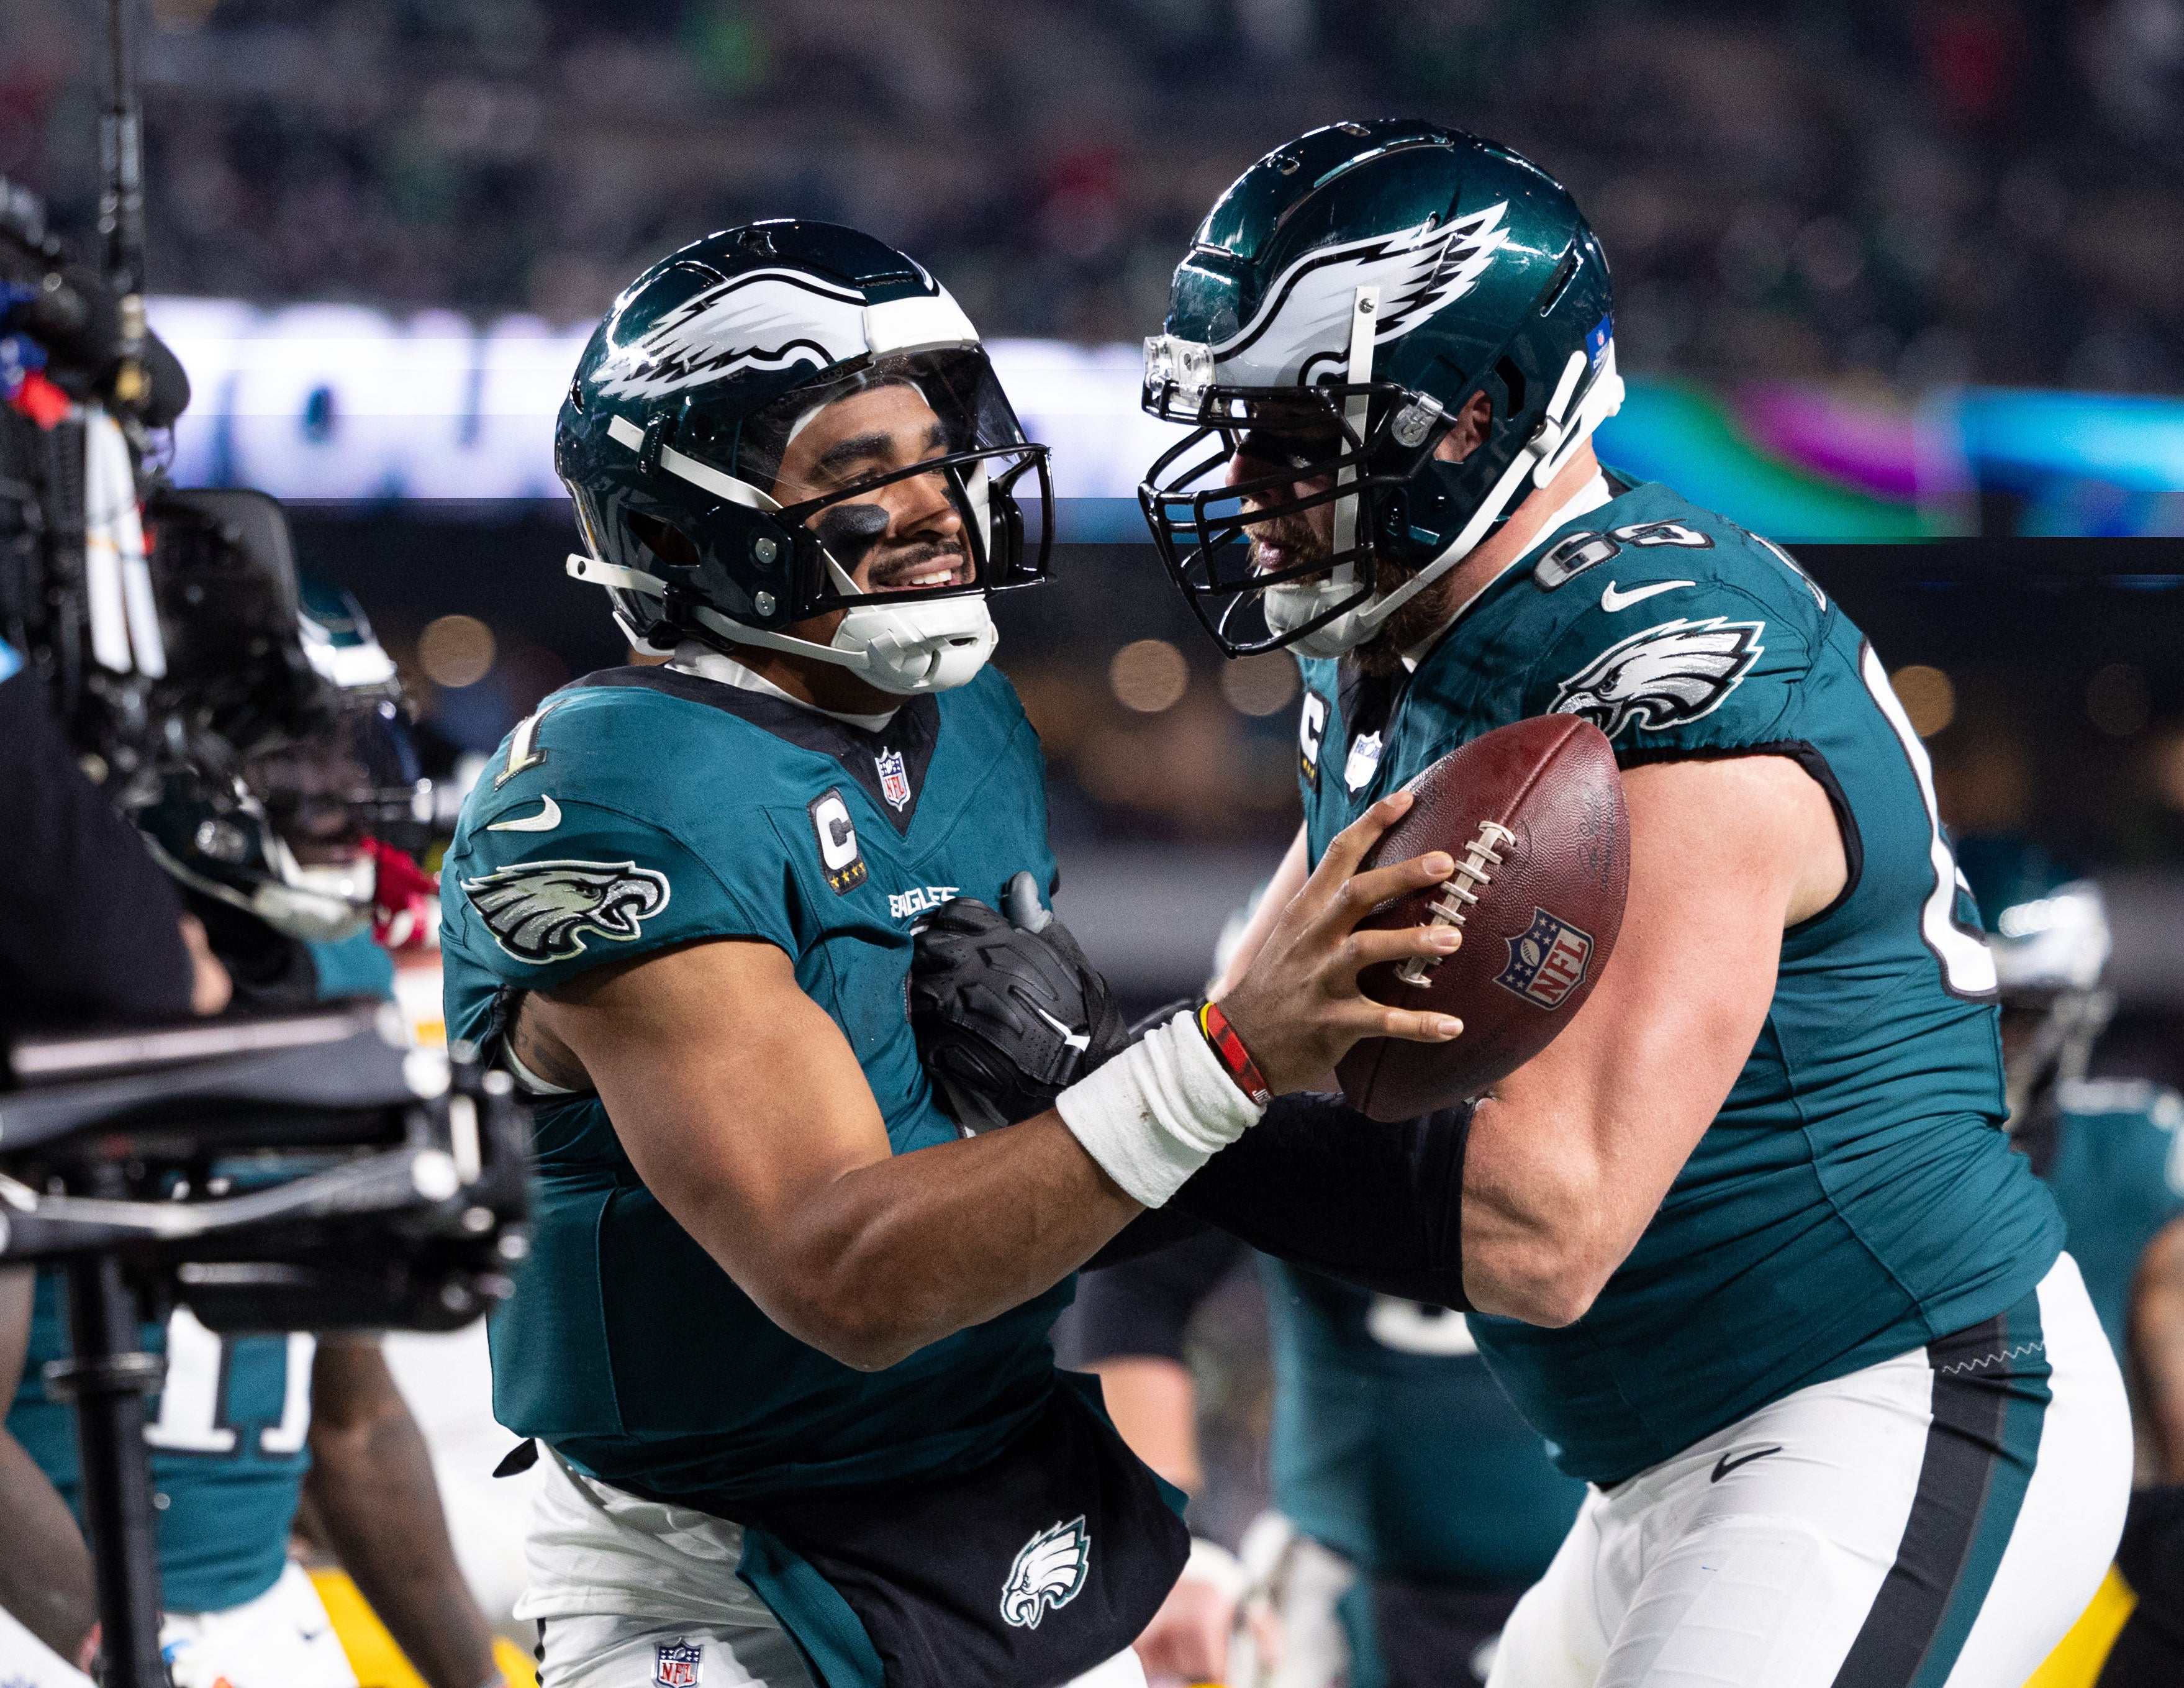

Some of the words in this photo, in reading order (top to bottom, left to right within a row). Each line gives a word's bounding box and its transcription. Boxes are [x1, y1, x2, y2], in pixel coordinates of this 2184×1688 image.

[1300, 691, 1324, 765] C
[884, 775, 905, 800] NFL
[816, 797, 858, 870] C
[1530, 939, 1587, 1002] NFL
[659, 1662, 695, 1686] NFL
